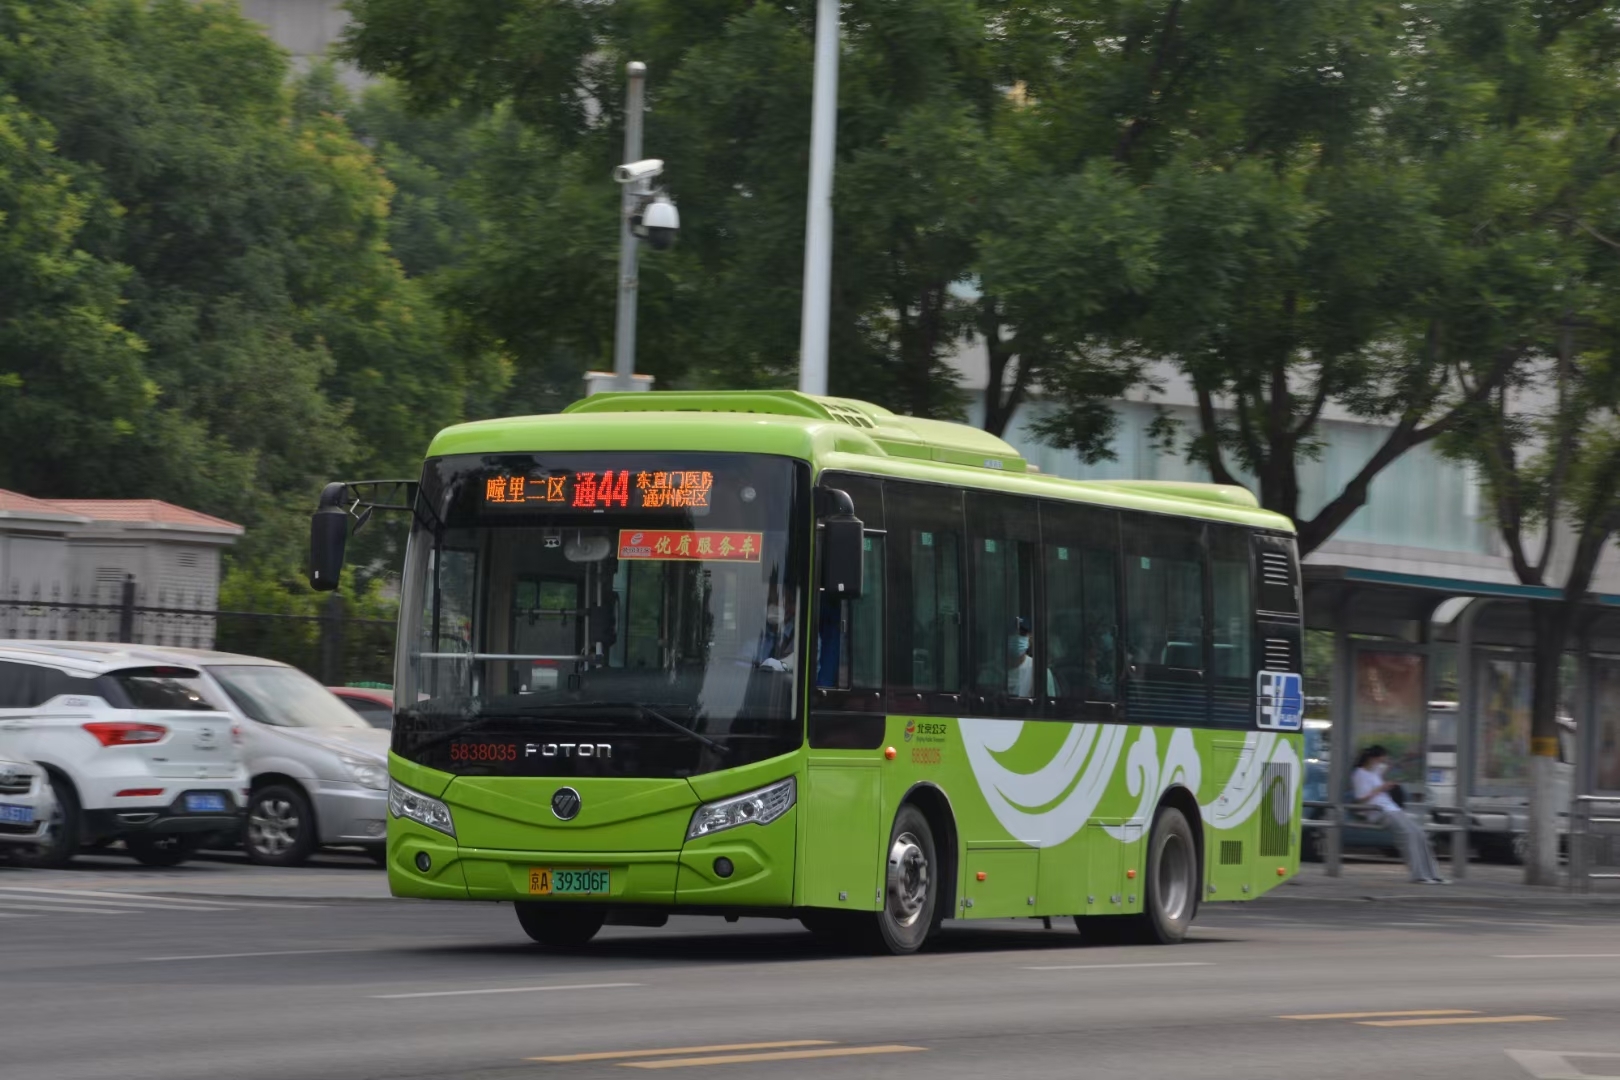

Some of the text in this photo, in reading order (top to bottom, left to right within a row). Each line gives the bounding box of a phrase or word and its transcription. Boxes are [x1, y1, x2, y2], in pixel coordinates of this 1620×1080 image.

[572, 470, 629, 507] 通44
[642, 488, 709, 507] 通州院区
[654, 534, 755, 559] 优质服务车
[916, 723, 947, 735] 北京公交
[450, 743, 517, 761] 5838035
[524, 743, 612, 757] FOTON
